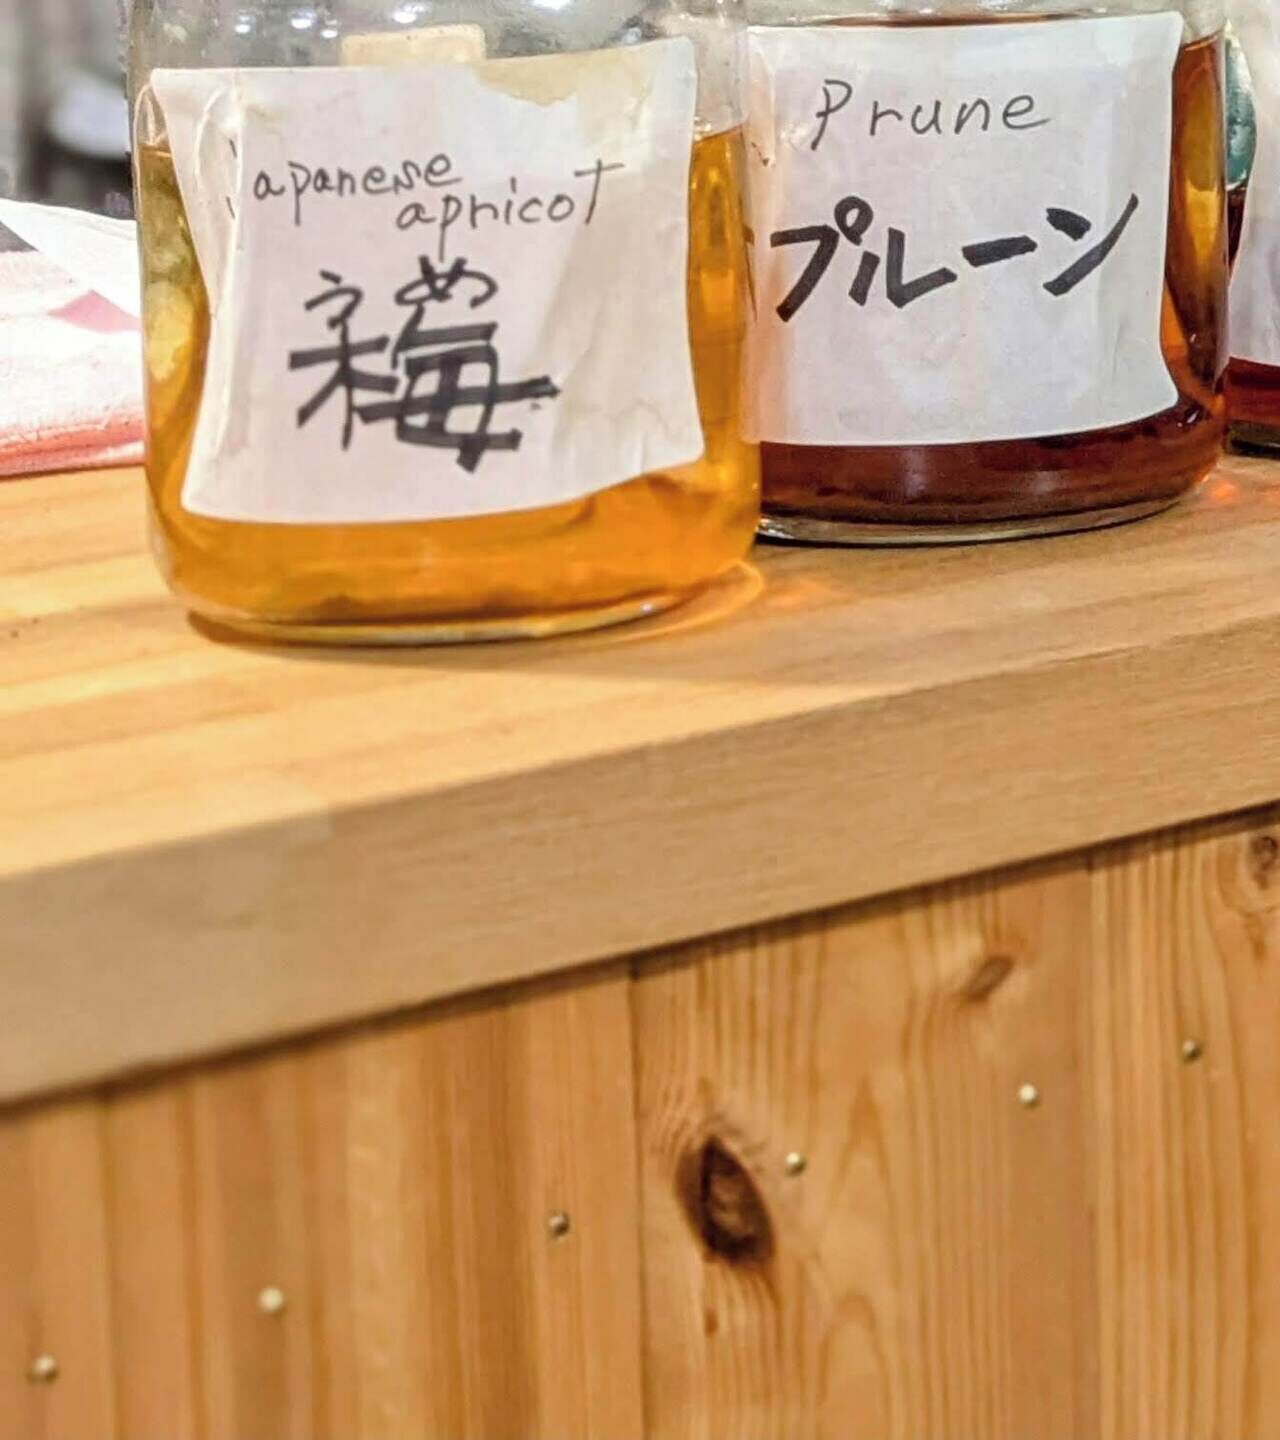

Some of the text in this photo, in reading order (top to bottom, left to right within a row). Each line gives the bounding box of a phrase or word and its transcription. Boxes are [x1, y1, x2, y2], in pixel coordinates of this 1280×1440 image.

[810, 78, 1052, 152] Prune
[228, 140, 462, 225] apanese
[398, 158, 626, 262] apricot
[769, 193, 1140, 323] プルーン
[287, 305, 559, 473] 梅
